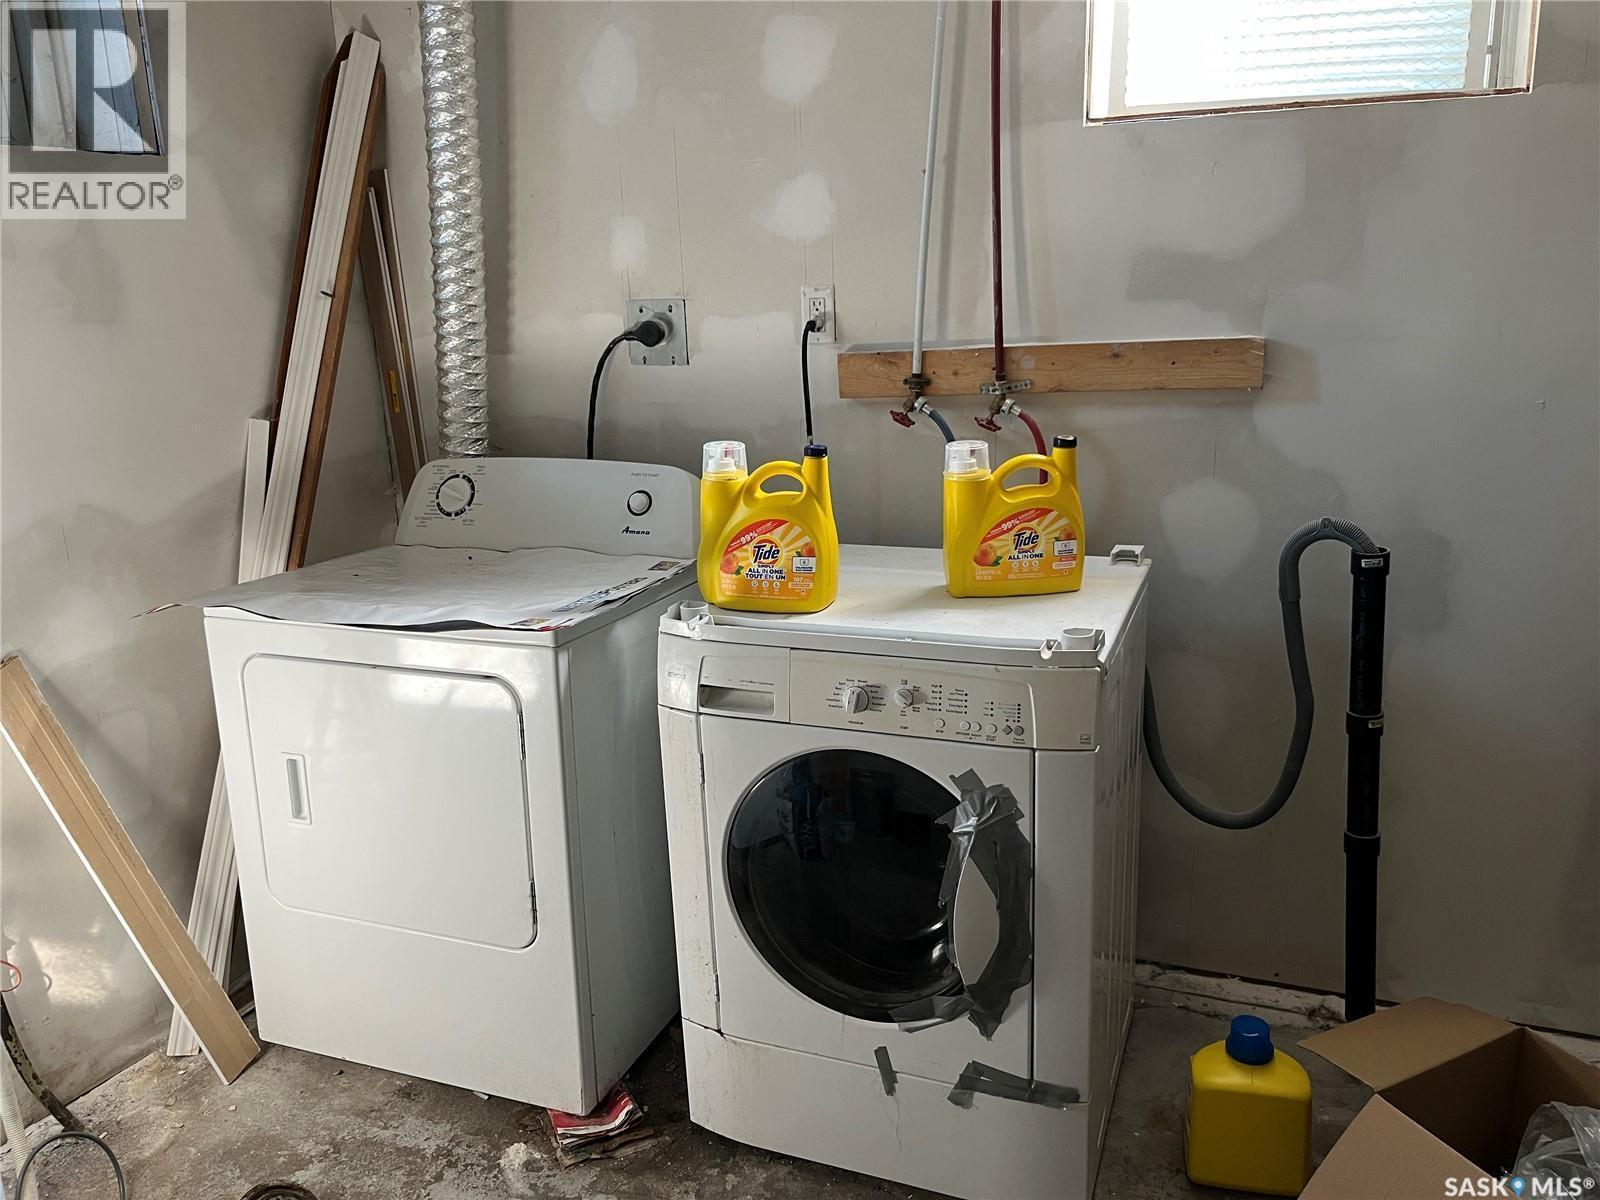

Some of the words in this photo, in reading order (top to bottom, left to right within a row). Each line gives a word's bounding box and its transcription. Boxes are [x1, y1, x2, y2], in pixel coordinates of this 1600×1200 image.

[621, 526, 650, 535] Amana
[1001, 518, 1020, 531] 99%
[740, 530, 758, 545] 99%
[1013, 531, 1039, 550] Tide
[753, 543, 780, 563] Tide
